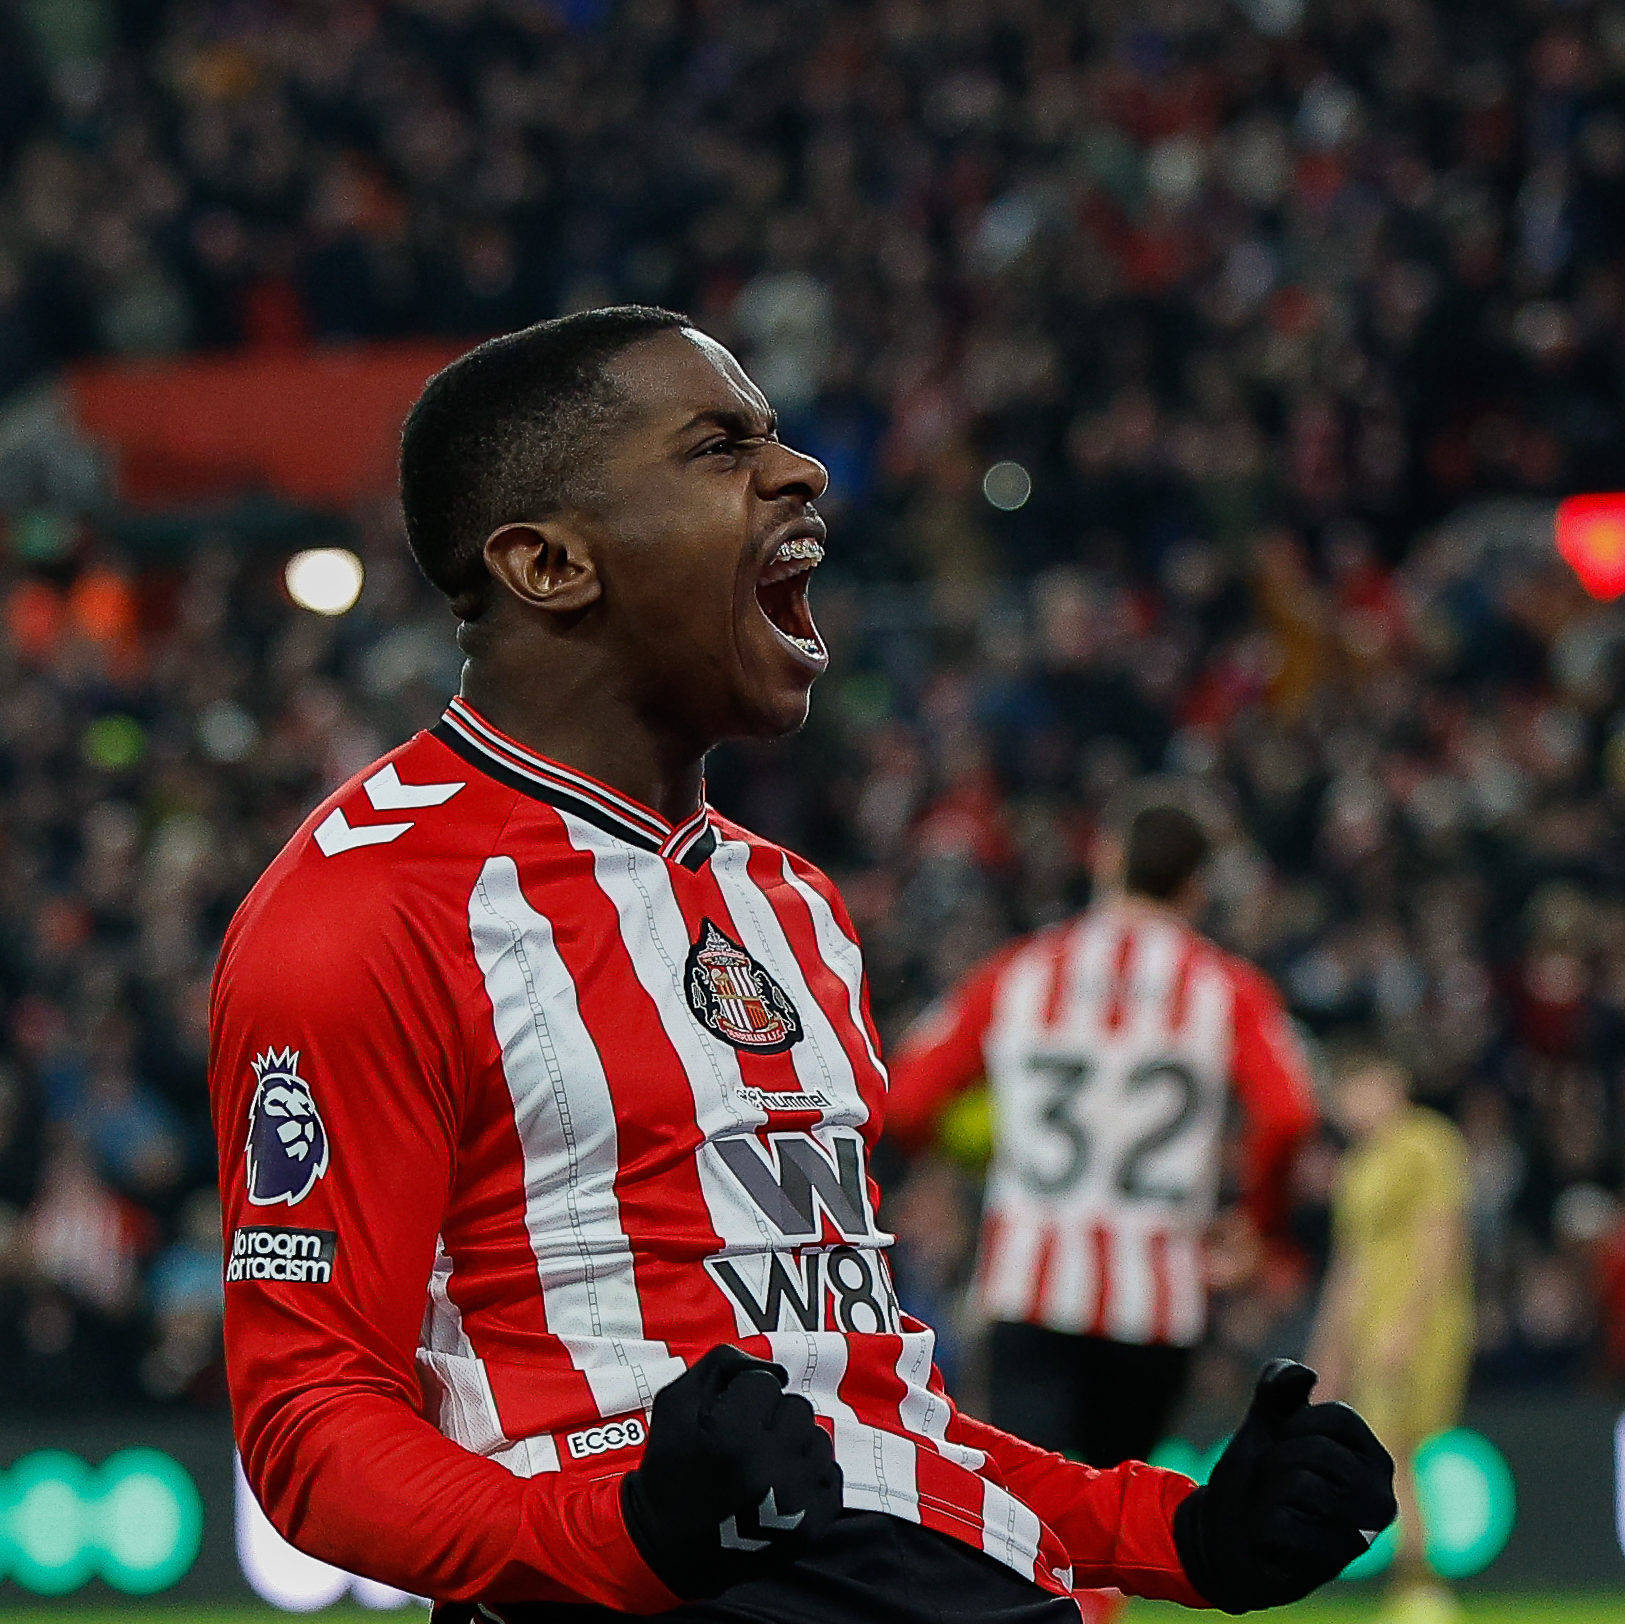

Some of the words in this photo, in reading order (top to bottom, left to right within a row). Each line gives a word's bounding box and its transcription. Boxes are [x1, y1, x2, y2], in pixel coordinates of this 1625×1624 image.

[757, 1089, 832, 1108] hummel
[1021, 1051, 1196, 1200] 32
[712, 1138, 869, 1236] W
[247, 1231, 321, 1258] room
[246, 1257, 331, 1283] racism
[712, 1247, 899, 1333] W8
[572, 1422, 641, 1454] ECO8
